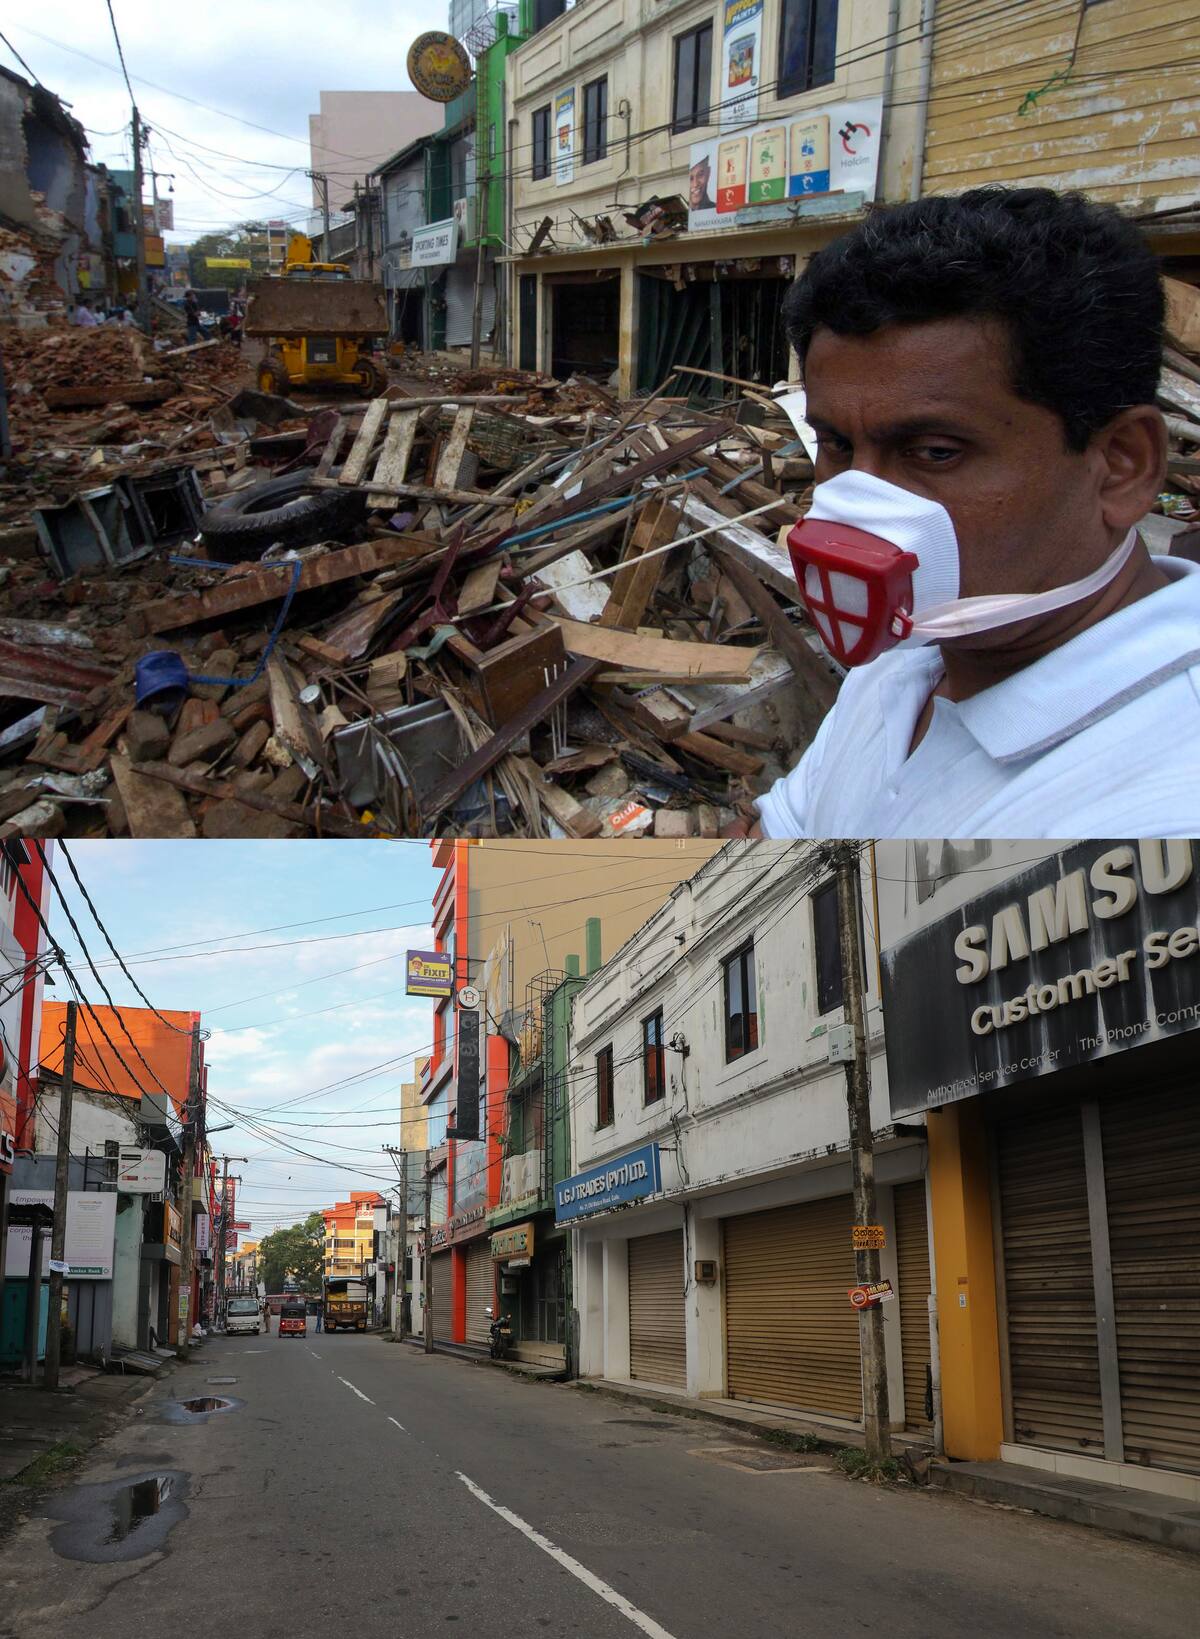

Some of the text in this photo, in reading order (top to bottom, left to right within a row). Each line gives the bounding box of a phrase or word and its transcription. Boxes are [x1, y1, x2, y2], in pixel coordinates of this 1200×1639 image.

[840, 155, 870, 169] Holcim
[954, 839, 1194, 985] SAMSU
[423, 968, 447, 978] FIXIT
[971, 949, 1137, 1035] Customer
[927, 1074, 977, 1098] Authorized
[978, 1062, 1018, 1083] Service
[1020, 1048, 1061, 1070] Center
[1079, 1032, 1104, 1052] The
[1107, 1019, 1151, 1043] Phone
[576, 1176, 606, 1199] TRADES
[606, 1164, 629, 1191] (PVT)
